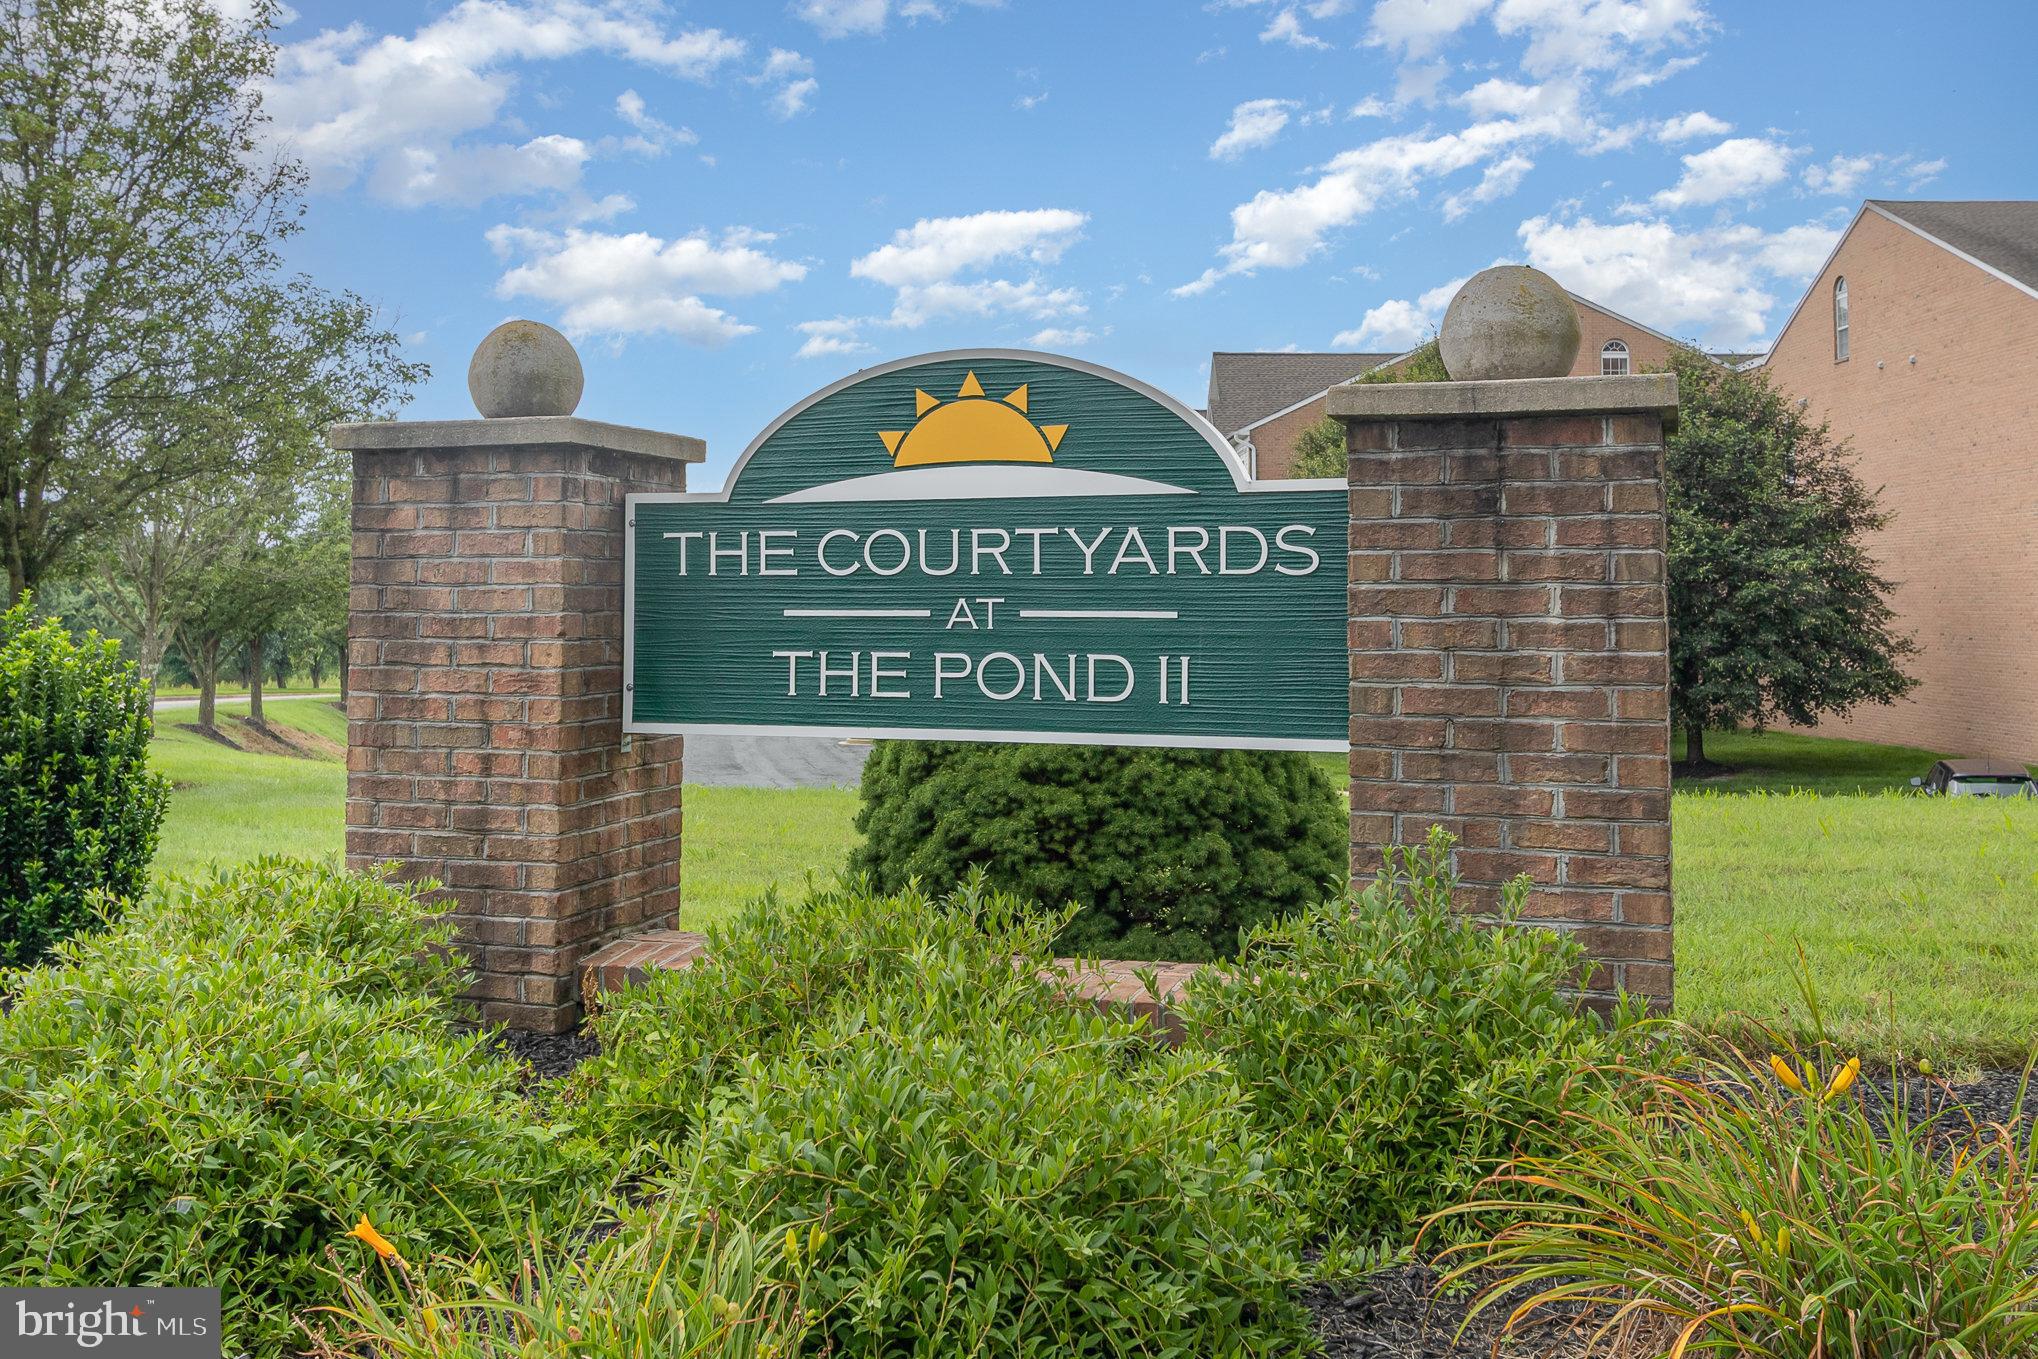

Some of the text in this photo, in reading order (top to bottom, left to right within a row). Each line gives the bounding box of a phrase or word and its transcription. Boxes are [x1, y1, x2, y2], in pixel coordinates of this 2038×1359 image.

[663, 524, 1321, 577] THE COURTYARDS
[945, 597, 1004, 630] AT
[772, 650, 1191, 705] THE POND II
